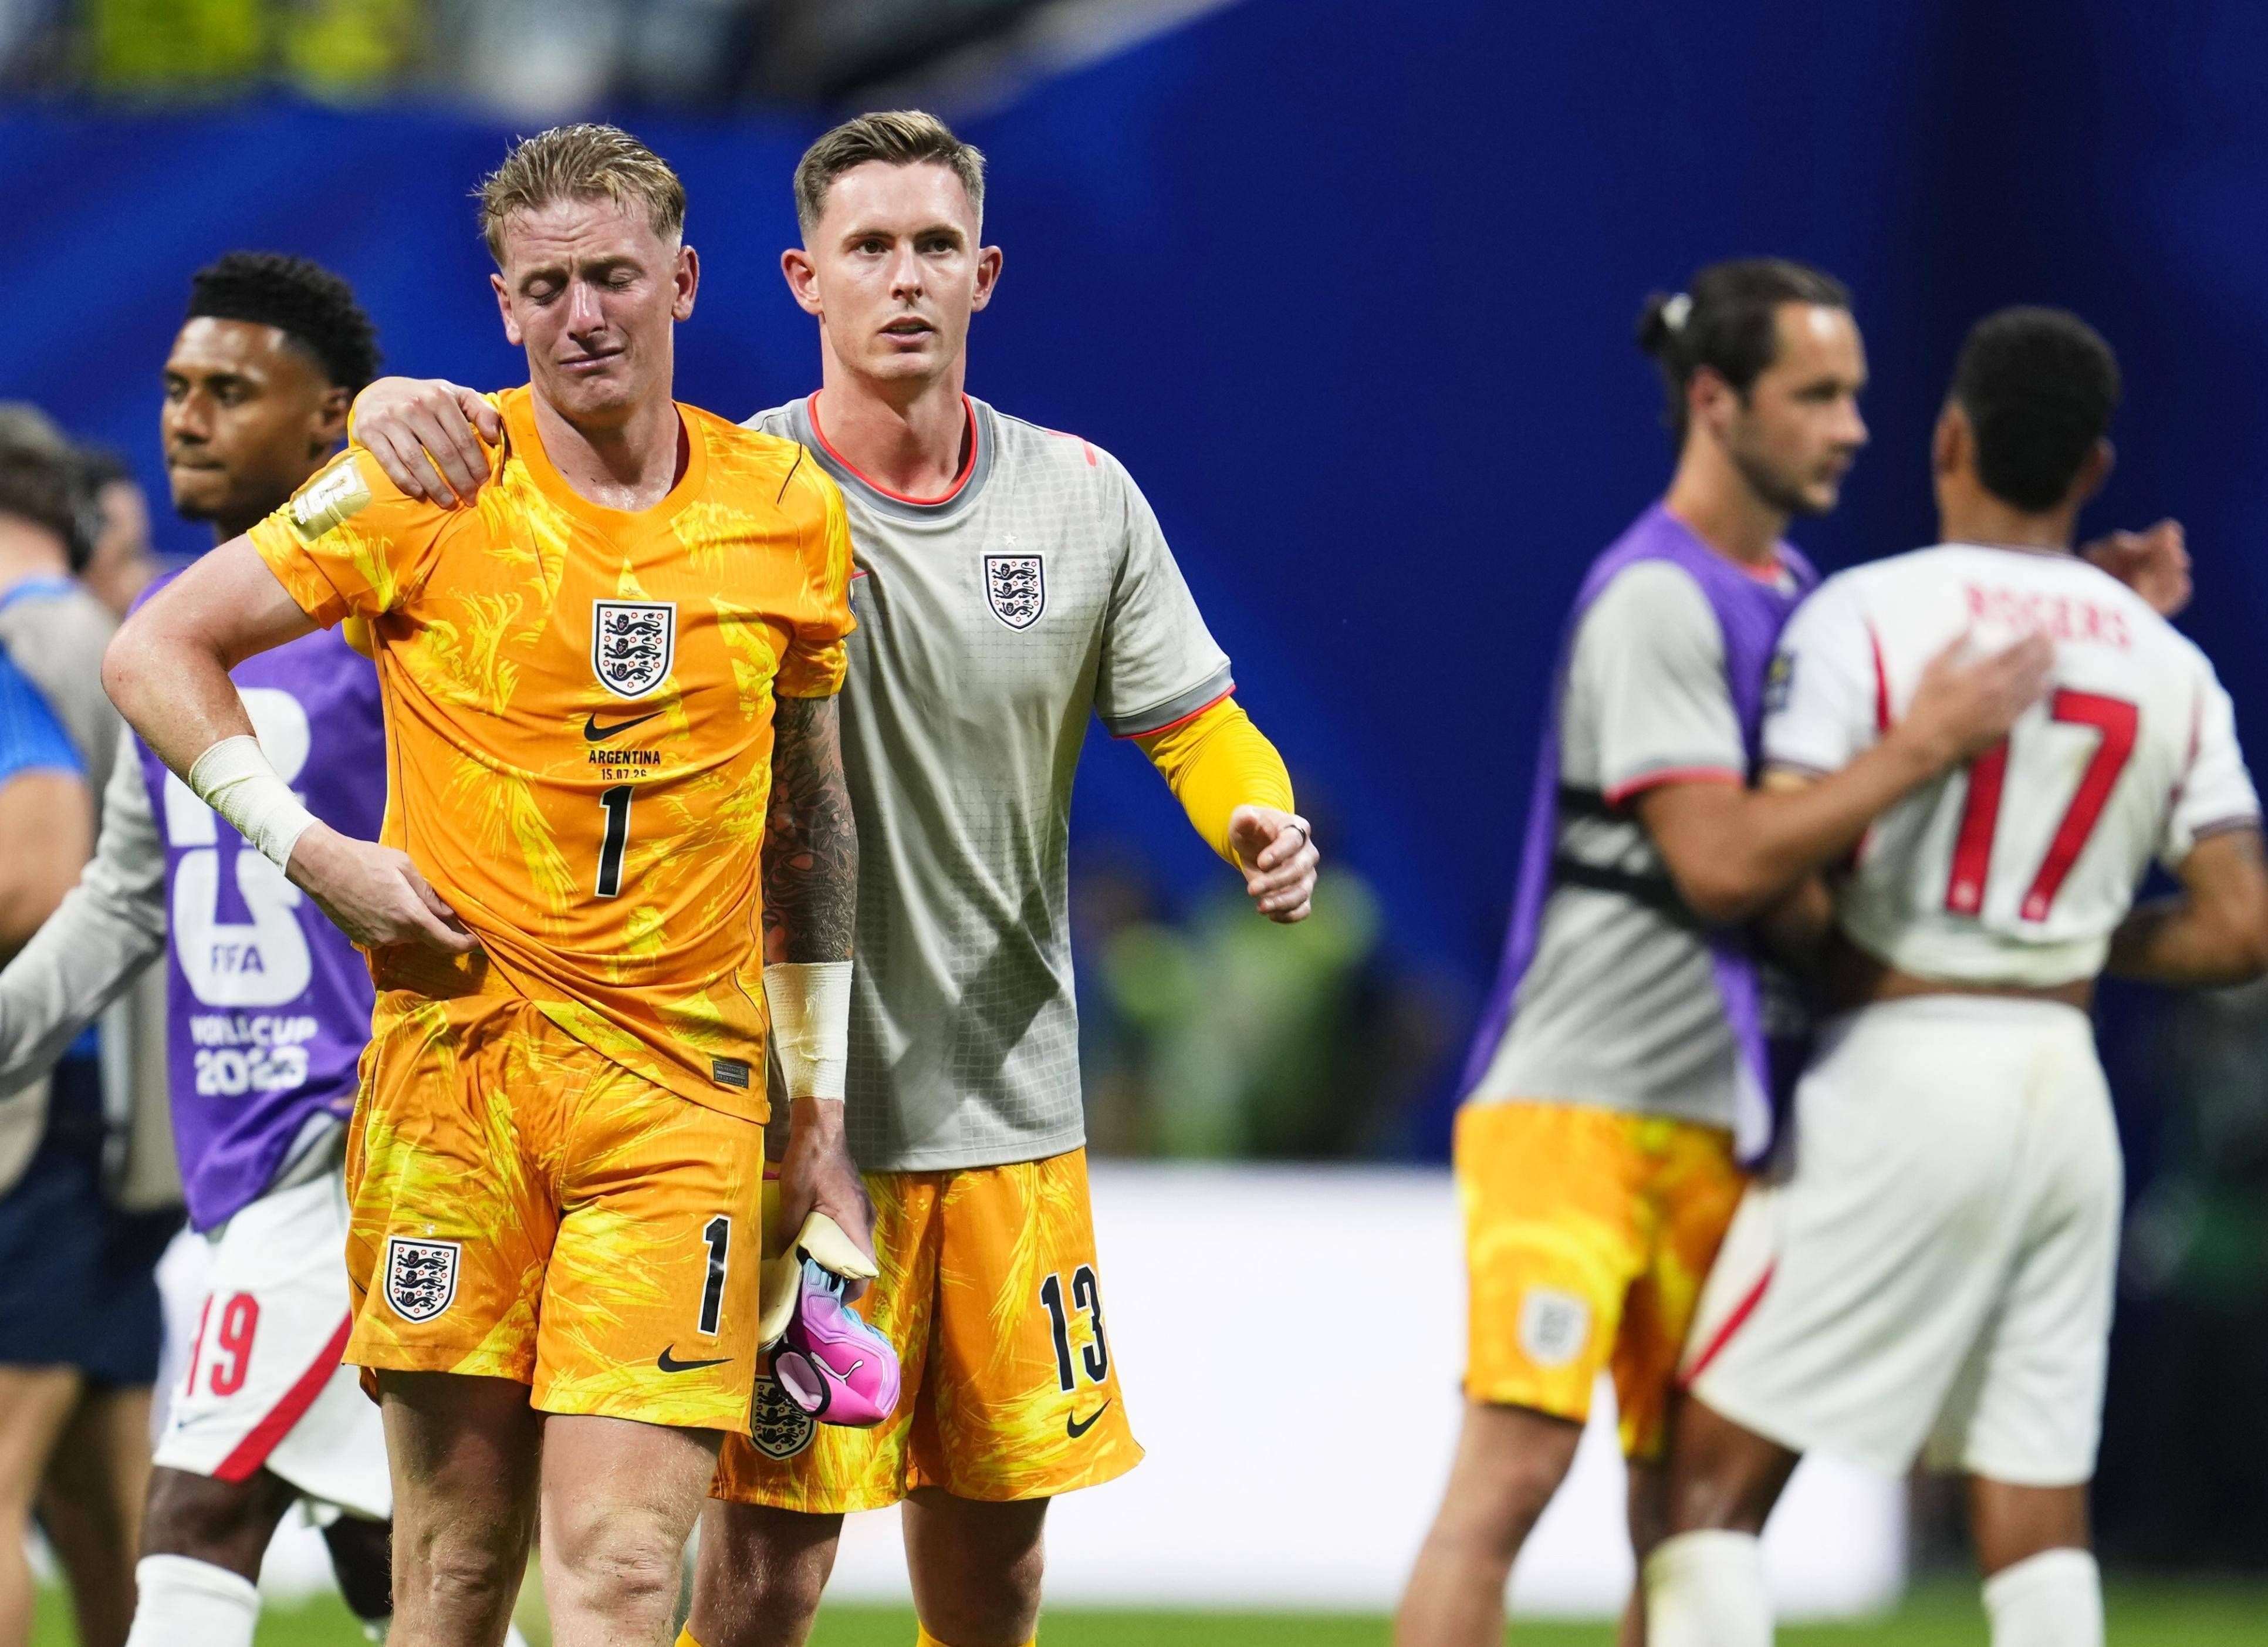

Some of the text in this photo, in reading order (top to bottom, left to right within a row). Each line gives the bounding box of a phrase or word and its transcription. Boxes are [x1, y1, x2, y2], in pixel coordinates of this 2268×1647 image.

[589, 750, 660, 764] ARGENTINA
[602, 768, 647, 780] 15.07.26
[1946, 688, 2139, 920] 17
[594, 784, 635, 897] 1
[211, 944, 265, 972] FIFA
[250, 1015, 319, 1045] CUP
[697, 1214, 731, 1337] 1
[1039, 1263, 1108, 1395] 13
